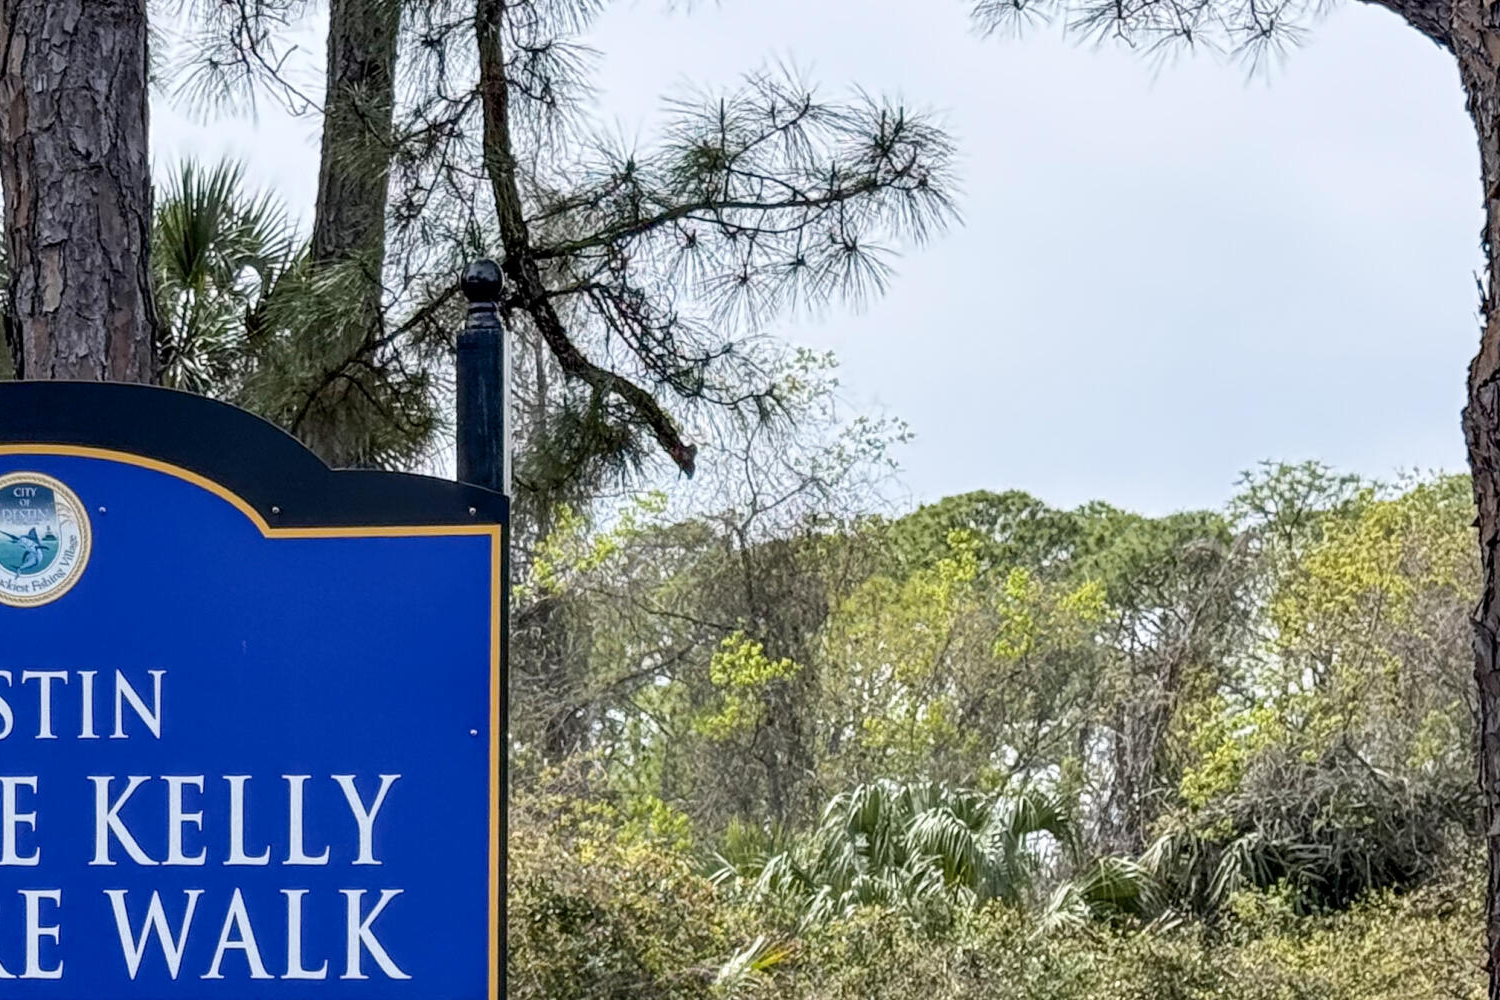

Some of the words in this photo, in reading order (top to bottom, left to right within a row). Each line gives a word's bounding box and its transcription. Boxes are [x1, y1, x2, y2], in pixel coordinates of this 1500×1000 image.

[13, 487, 37, 498] CITY
[31, 568, 66, 593] Fishing
[60, 534, 80, 567] Village
[87, 773, 402, 867] KELLY
[103, 886, 413, 981] WALK
